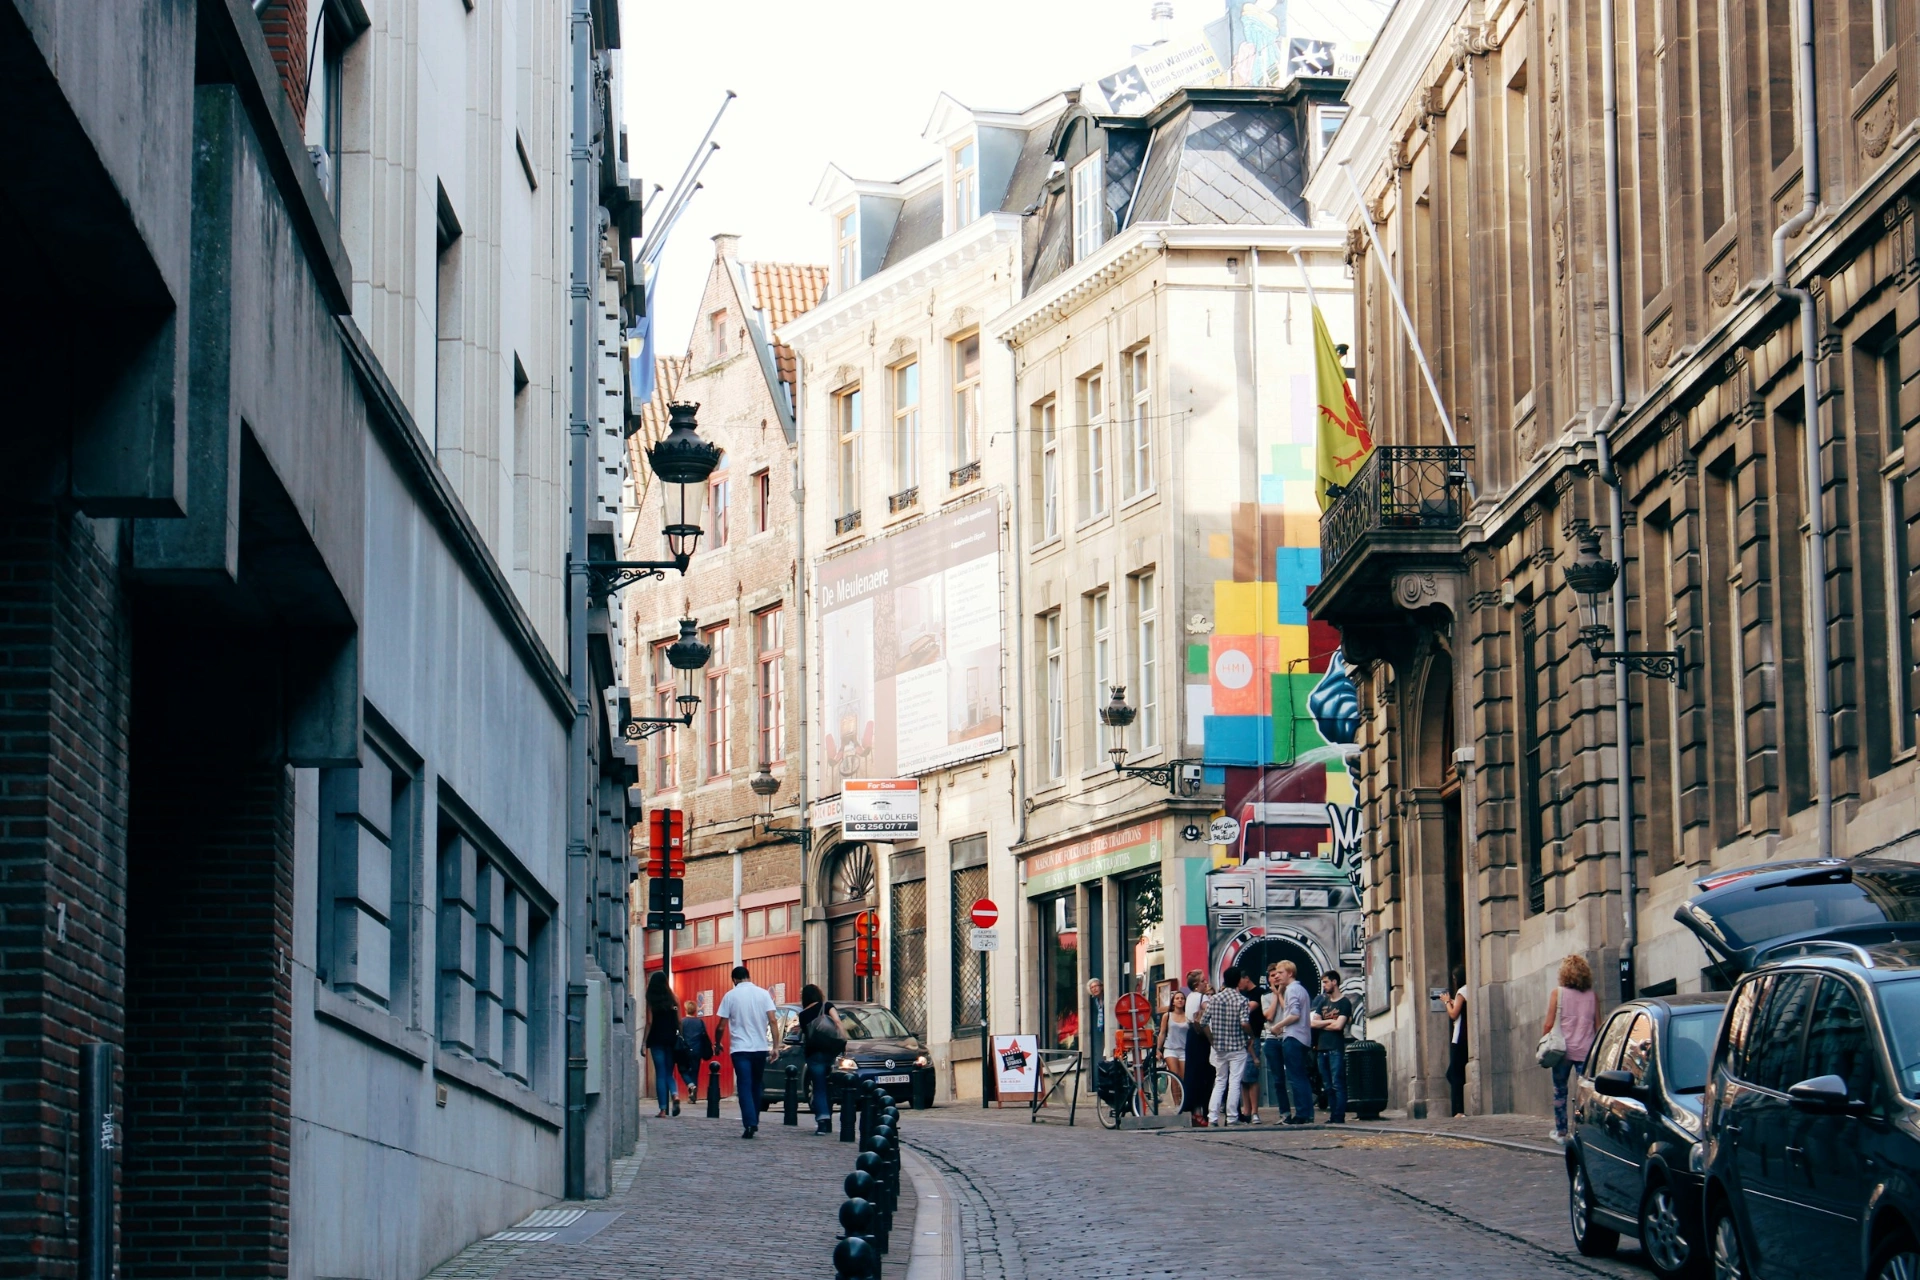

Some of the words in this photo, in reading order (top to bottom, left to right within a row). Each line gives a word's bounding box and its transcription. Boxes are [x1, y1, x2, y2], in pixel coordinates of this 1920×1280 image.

[1143, 61, 1165, 77] Plan
[1150, 74, 1172, 90] Geen
[1171, 62, 1199, 80] Sprake
[1198, 55, 1215, 67] Van
[822, 584, 834, 609] De
[836, 567, 889, 603] Meulenaere
[1221, 663, 1245, 673] HMI
[854, 823, 866, 831] 02
[867, 823, 883, 831] 256
[1035, 853, 1056, 871] MAISON
[1055, 851, 1063, 866] DU
[1064, 842, 1090, 863] FOLKLORE
[1090, 840, 1098, 854] ET
[1098, 837, 1108, 852] DES
[1108, 827, 1142, 848] TRADITIONS
